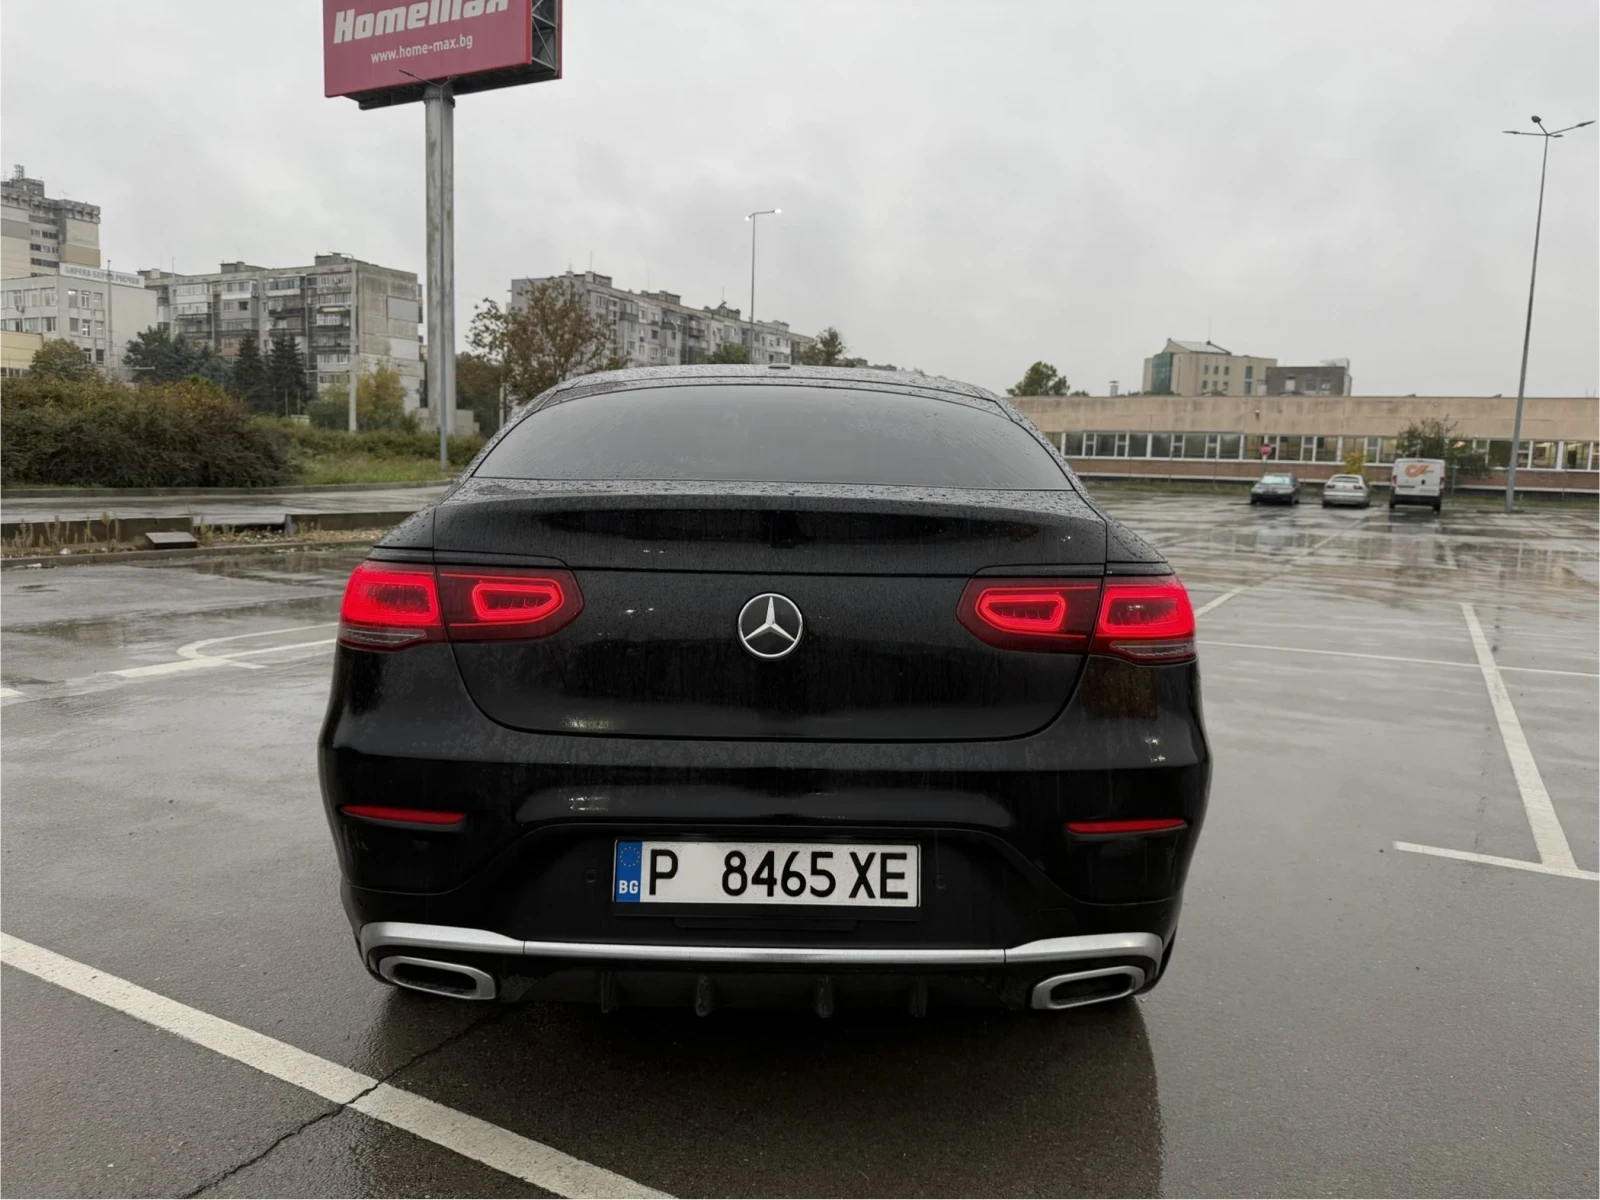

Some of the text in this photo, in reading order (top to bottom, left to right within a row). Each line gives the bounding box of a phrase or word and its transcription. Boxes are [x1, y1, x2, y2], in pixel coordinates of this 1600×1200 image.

[370, 34, 473, 64] www.home-max.bg
[618, 880, 639, 894] BG
[649, 848, 909, 900] P 8465 XE
